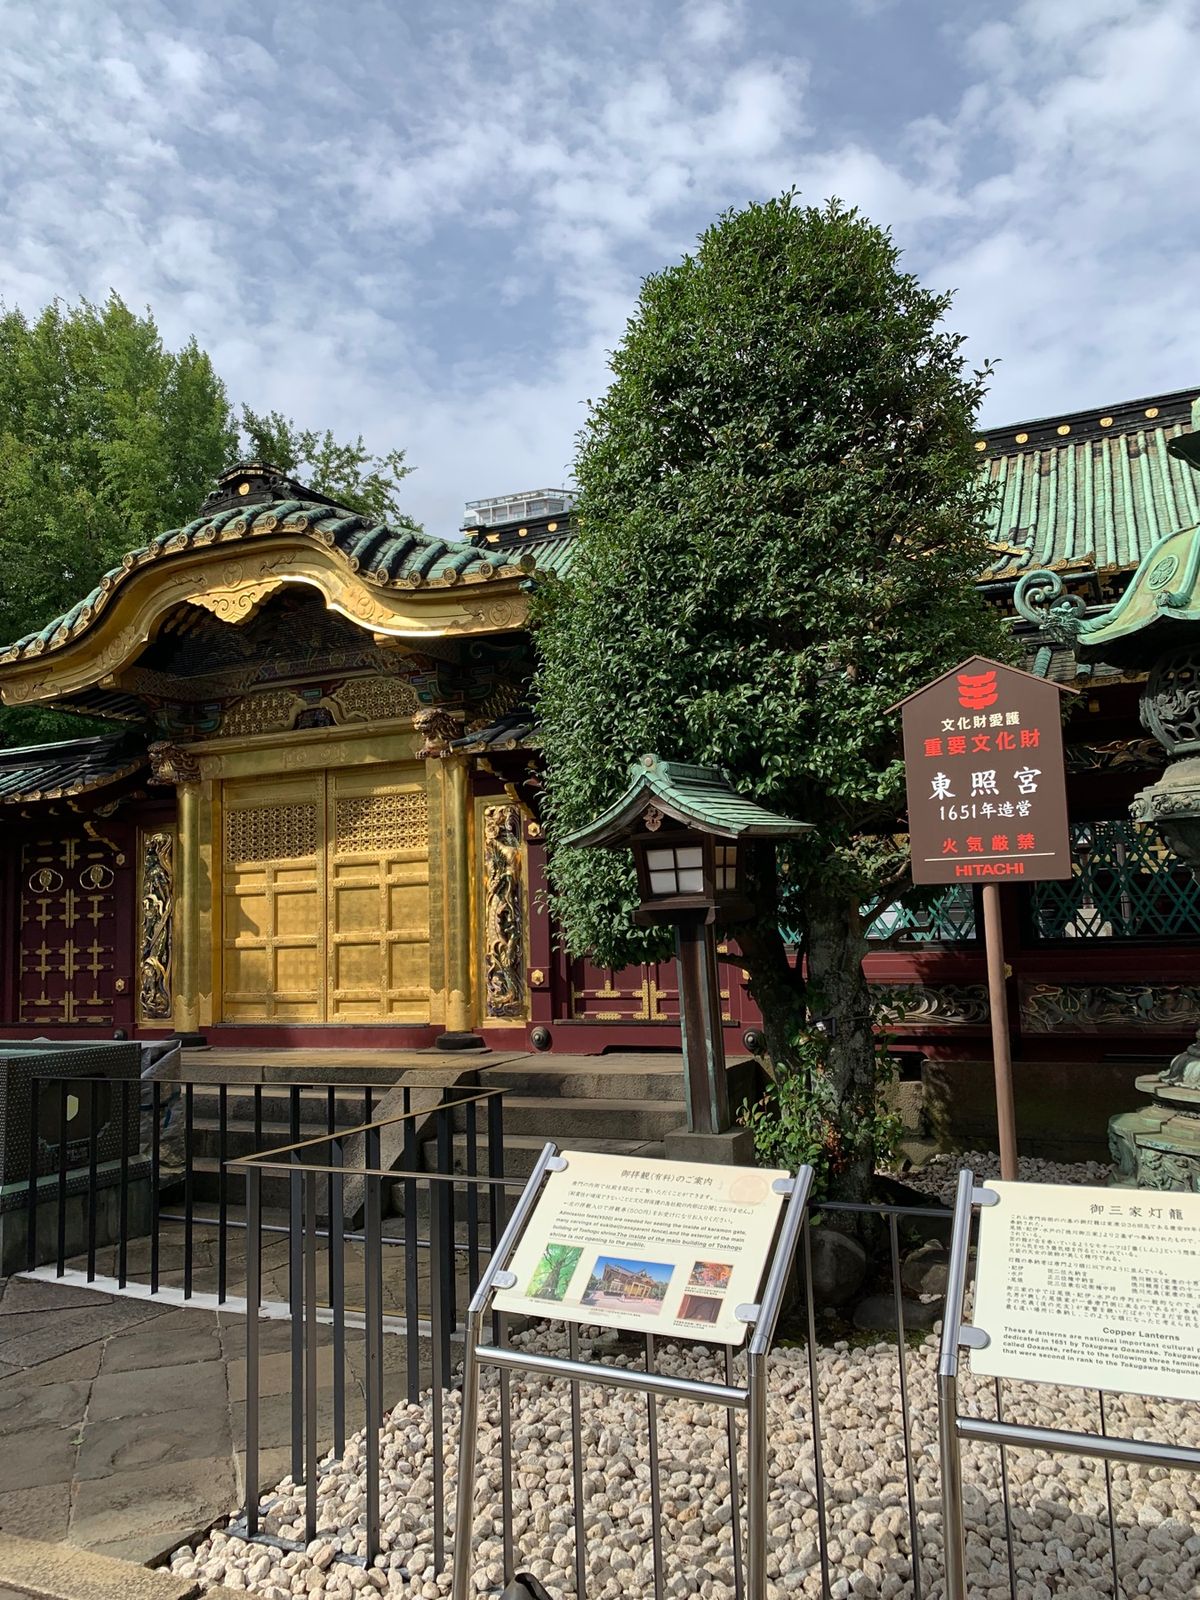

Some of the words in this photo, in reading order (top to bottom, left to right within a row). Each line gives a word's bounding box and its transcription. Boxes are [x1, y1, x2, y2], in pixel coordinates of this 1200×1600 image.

[941, 711, 1021, 732] 文化財愛護
[923, 728, 1041, 757] 重要文化財
[928, 766, 1042, 801] 東照宮
[939, 799, 1032, 821] 1651年造営
[942, 832, 1035, 854] 火気厳禁
[955, 863, 1024, 877] HITACHI
[653, 1220, 671, 1229] seeing
[552, 1224, 572, 1233] building
[682, 1239, 707, 1248] building
[716, 1242, 743, 1252] Toshogu
[584, 1235, 608, 1245] opening
[626, 1240, 646, 1249] public.
[1004, 1334, 1040, 1342] dedicated
[1082, 1342, 1118, 1352] Tokugawa
[1035, 1330, 1066, 1338] lanterns
[1120, 1338, 1159, 1348] important
[1162, 1344, 1194, 1352] cultural
[1102, 1326, 1136, 1336] Copper
[1138, 1330, 1180, 1342] Lanterns
[1112, 1353, 1147, 1363] following
[1120, 1362, 1158, 1371] Tokugawa
